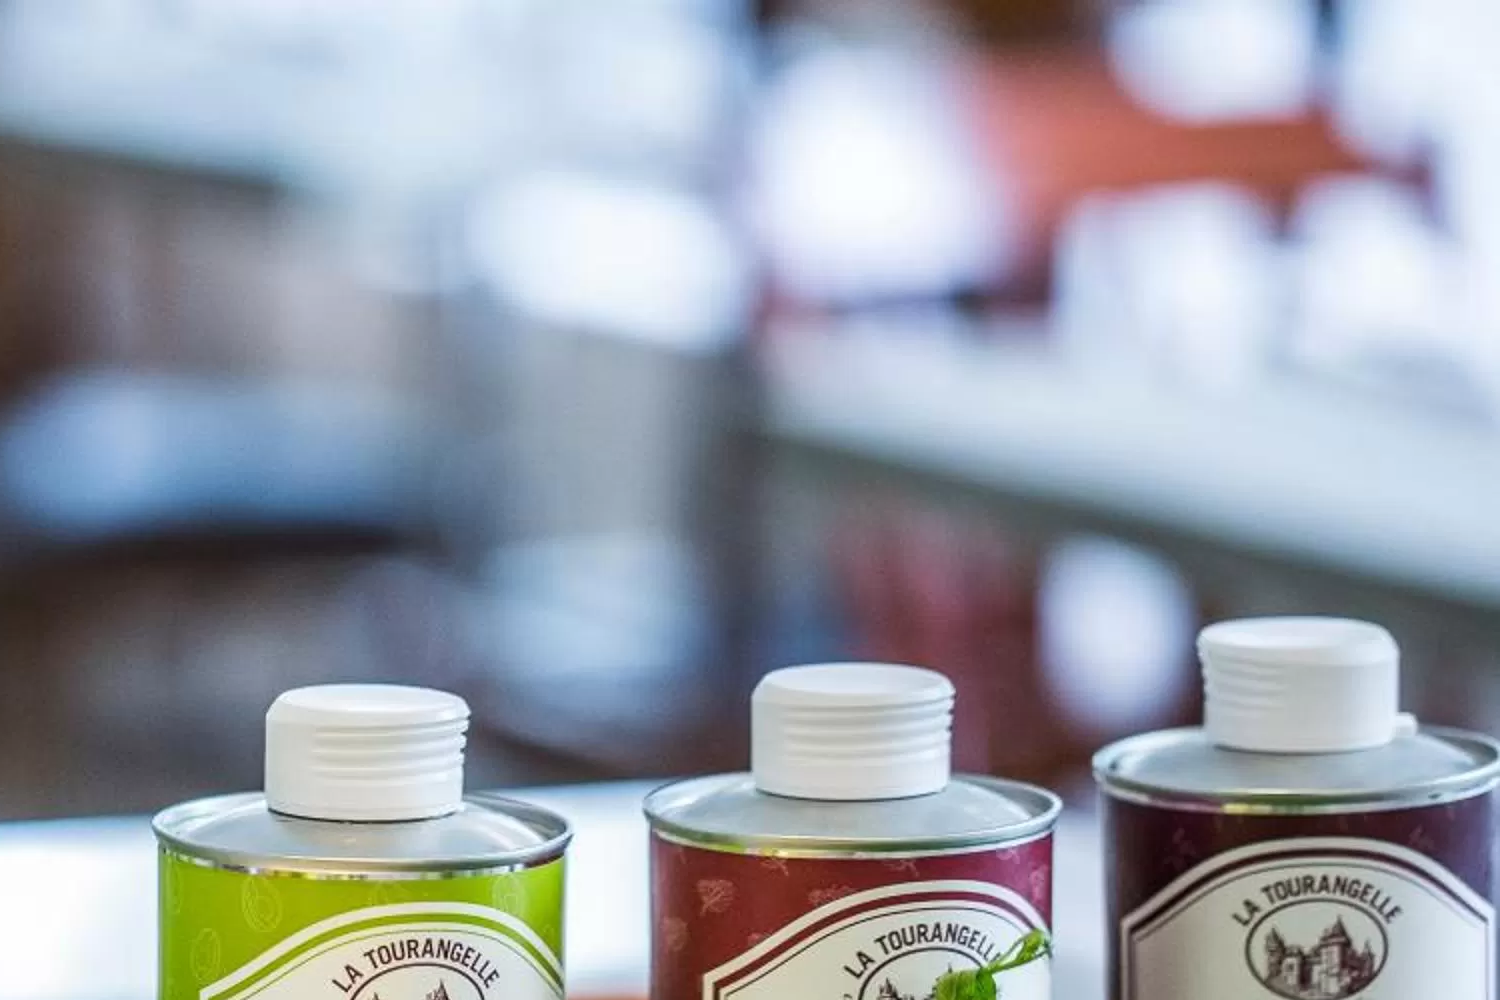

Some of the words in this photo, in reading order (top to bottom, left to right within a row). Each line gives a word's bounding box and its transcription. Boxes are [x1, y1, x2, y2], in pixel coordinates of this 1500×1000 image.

[1231, 898, 1262, 926] LA
[1261, 875, 1403, 924] TOURANGELLE
[332, 964, 364, 993] LA
[364, 938, 500, 989] TOURANGELLE
[844, 951, 875, 979] LA
